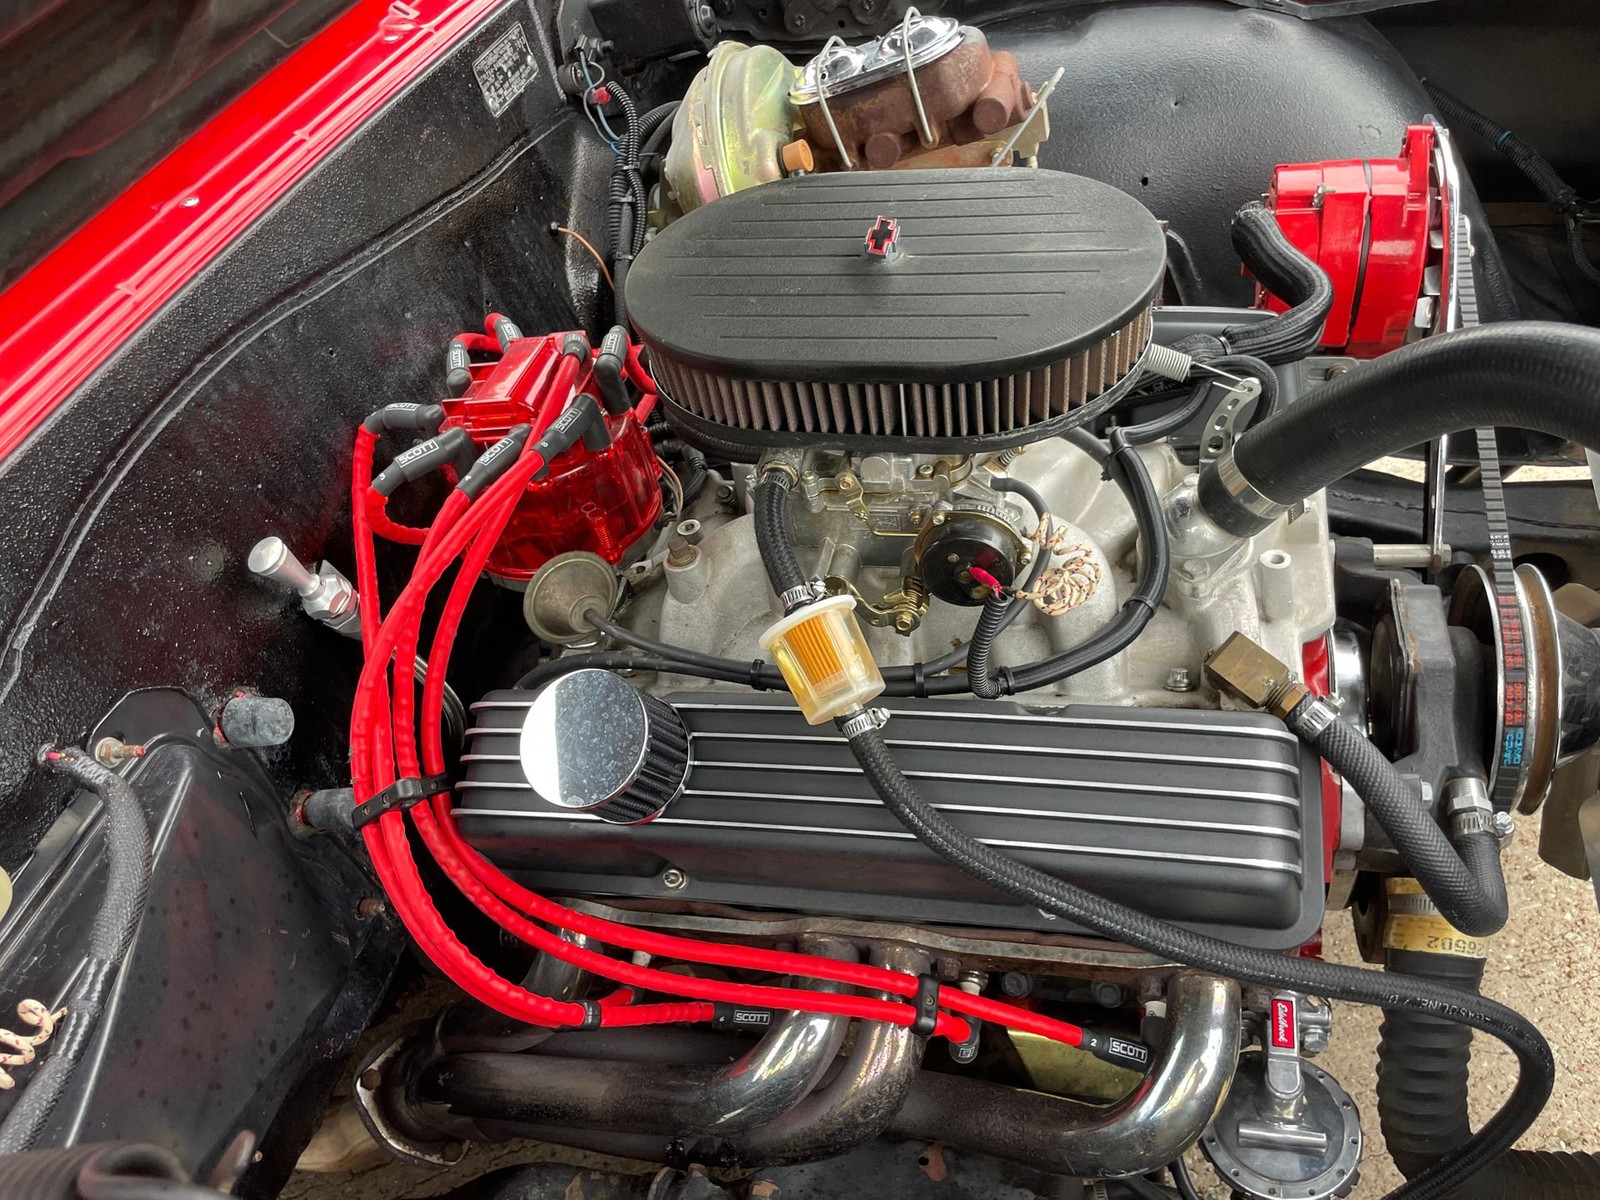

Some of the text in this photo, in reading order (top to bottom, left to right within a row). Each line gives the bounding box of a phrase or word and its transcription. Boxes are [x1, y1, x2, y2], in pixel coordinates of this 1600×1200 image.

[605, 333, 618, 353] SCOTT
[555, 408, 578, 431] SCOTT
[379, 441, 434, 481] 3 SCOTT
[480, 438, 510, 463] SCOTT
[735, 1013, 769, 1022] SCOTT
[1090, 1038, 1146, 1060] 2 SCOTT
